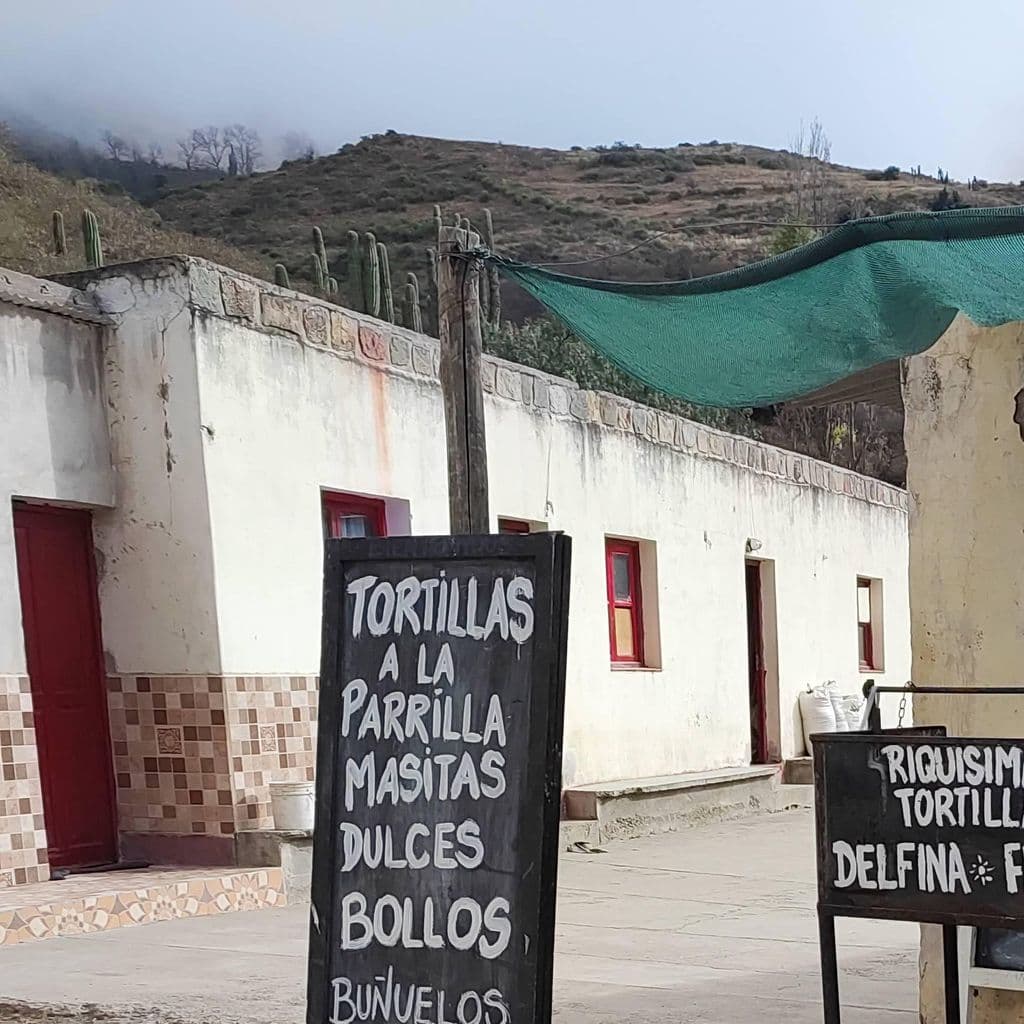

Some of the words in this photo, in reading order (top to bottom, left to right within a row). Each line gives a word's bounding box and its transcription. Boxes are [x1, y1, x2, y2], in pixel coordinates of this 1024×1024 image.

[348, 570, 534, 644] TORTILLAS
[378, 642, 398, 682] A
[417, 642, 454, 686] LA
[341, 678, 506, 747] PARRILLA
[344, 748, 506, 812] MASITAS
[340, 818, 484, 872] DULCES
[832, 840, 971, 895] DELFINA
[340, 891, 512, 959] BOLLOS
